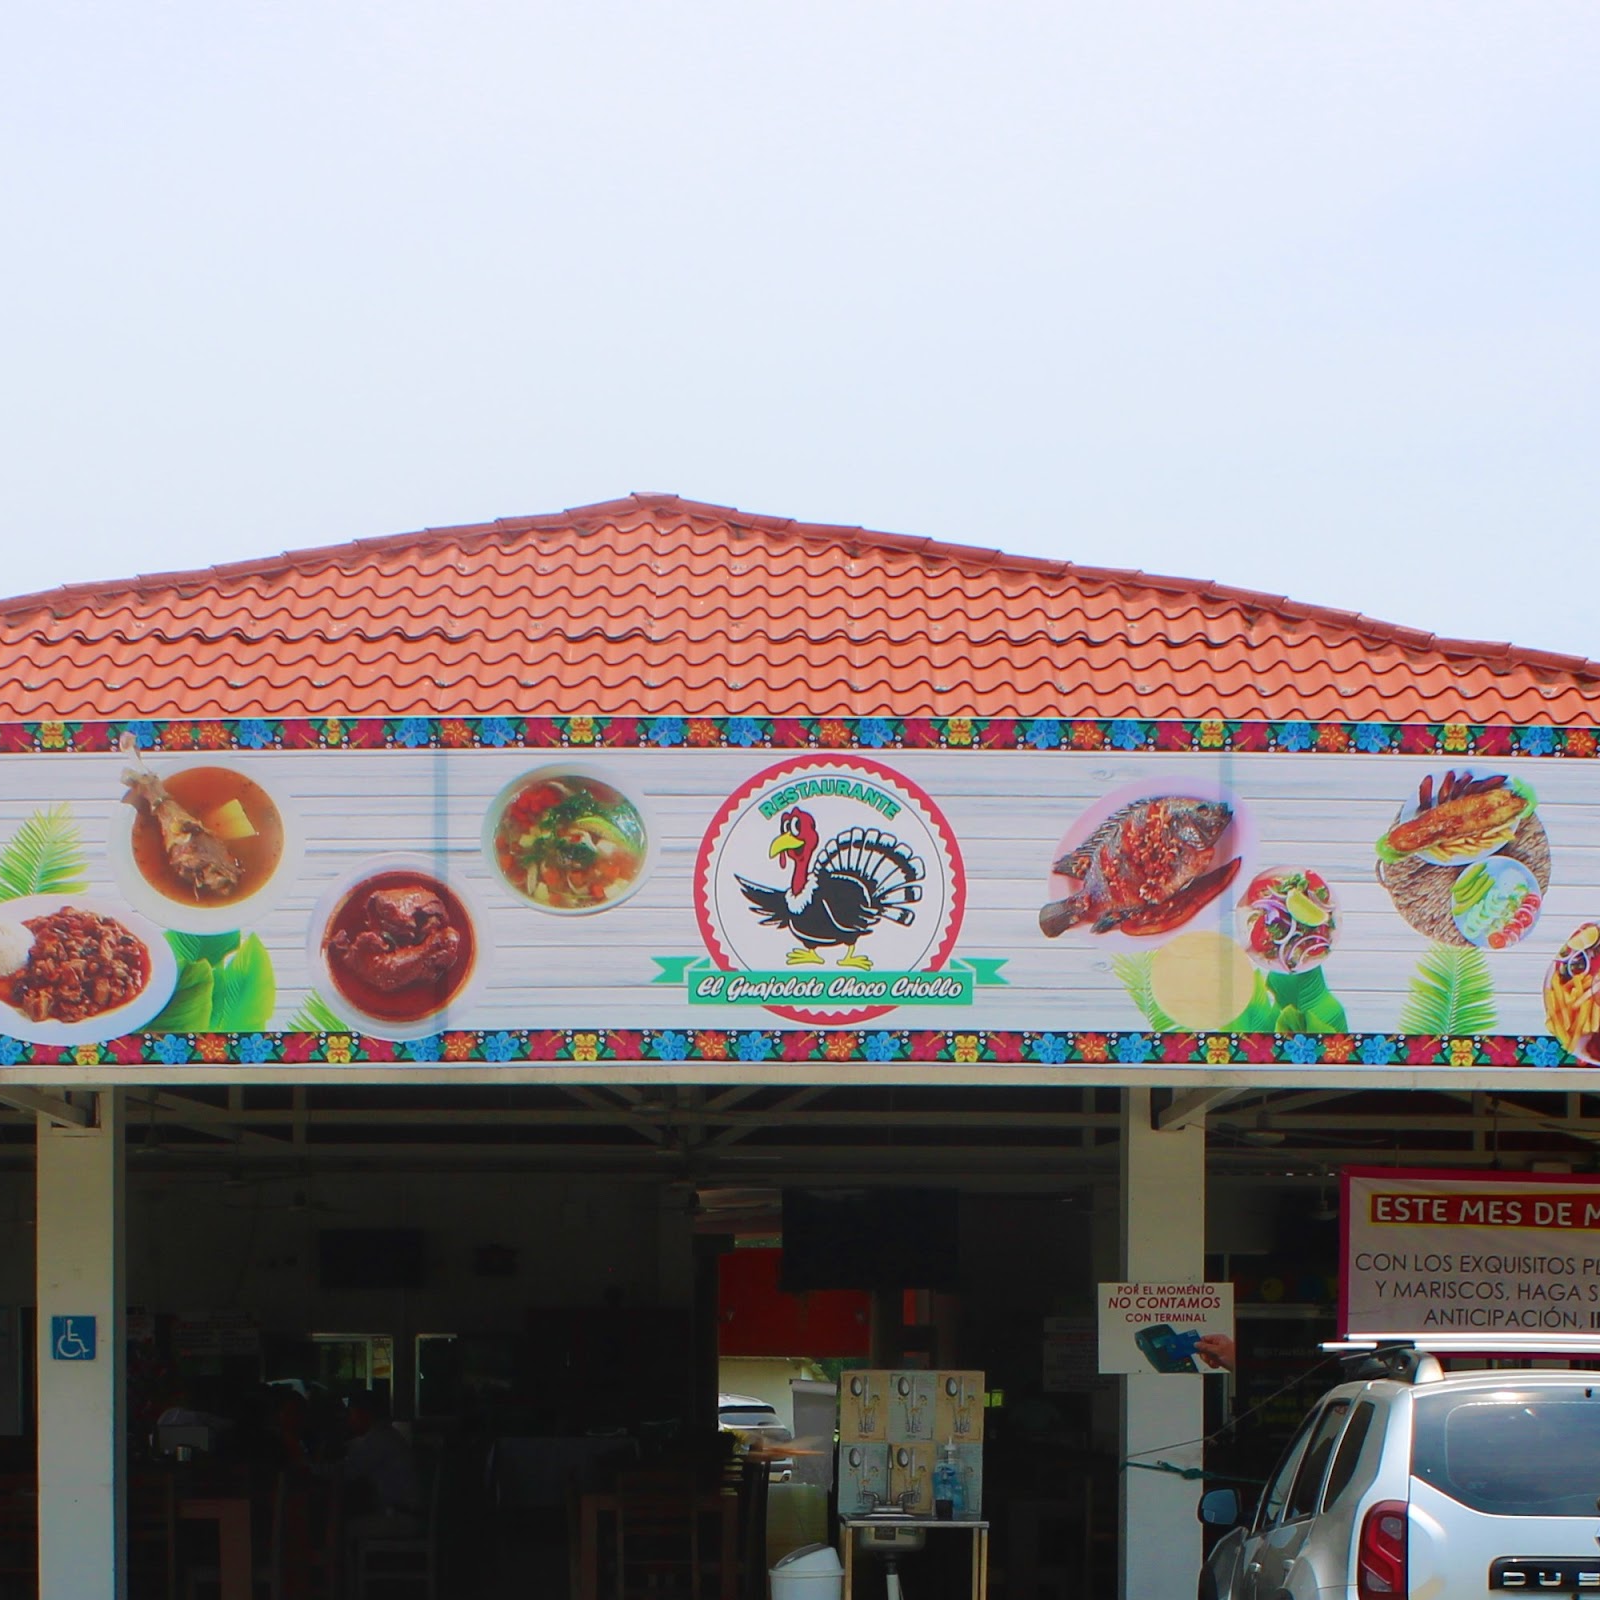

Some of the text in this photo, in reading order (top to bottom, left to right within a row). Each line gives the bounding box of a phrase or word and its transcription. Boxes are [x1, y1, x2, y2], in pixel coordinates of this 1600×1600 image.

[758, 779, 901, 821] RESTAURANTE
[697, 976, 963, 1001] El Guajolote Choco Criollo
[1375, 1197, 1448, 1222] ESTE
[1459, 1200, 1522, 1225] MES
[1534, 1202, 1572, 1226] DE
[1355, 1253, 1407, 1273] CON
[1414, 1254, 1452, 1273] LOS
[1460, 1255, 1575, 1275] EXQUISITOS
[1117, 1286, 1215, 1295] POR EL MOMENTO
[1375, 1281, 1387, 1298] Y
[1393, 1281, 1511, 1301] MARISCOS,
[1518, 1283, 1582, 1301] HAGA
[1108, 1297, 1221, 1309] NO CONTAMOS
[1125, 1313, 1207, 1323] CON TERMINAL
[1424, 1306, 1583, 1329] ANTICIPACIÓN,
